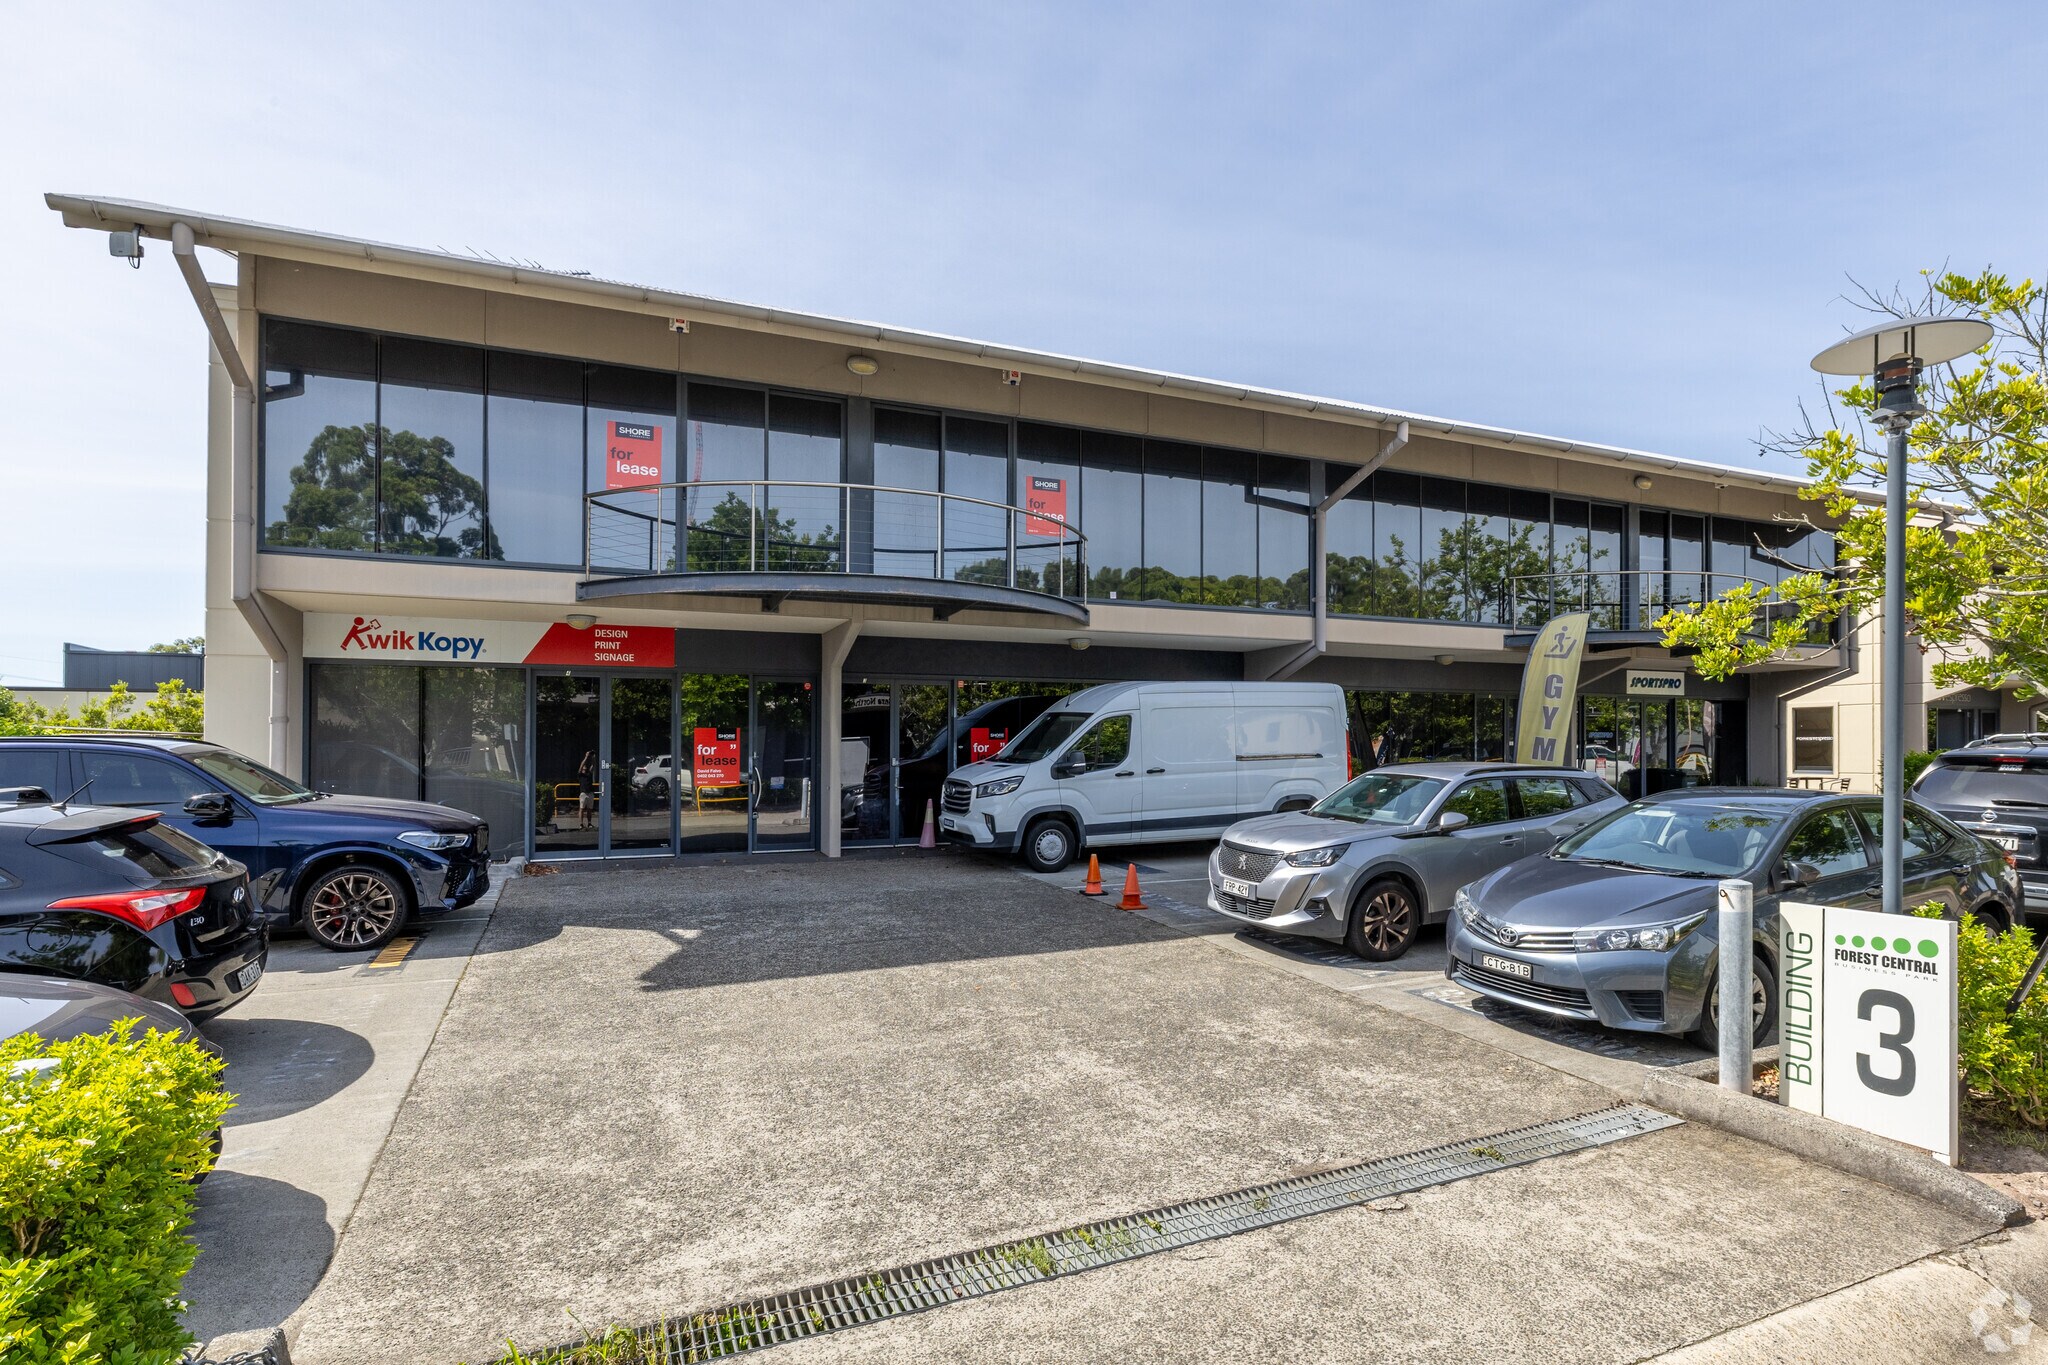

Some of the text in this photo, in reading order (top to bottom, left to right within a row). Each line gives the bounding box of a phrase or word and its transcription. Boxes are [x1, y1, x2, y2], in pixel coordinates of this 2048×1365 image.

[619, 427, 650, 437] SHORE
[610, 447, 633, 460] for
[616, 460, 659, 477] lease
[1029, 498, 1046, 509] for
[594, 629, 628, 638] DESIGN
[594, 641, 621, 650] PRINT
[594, 652, 635, 662] SIGNAGE
[1630, 677, 1681, 689] SPORTSPRO
[1532, 674, 1564, 762] GYM
[697, 744, 717, 755] for
[973, 743, 990, 752] for
[702, 755, 737, 766] lease
[190, 916, 205, 926] i30
[1834, 948, 1939, 976] FOREST CENTRAL
[1834, 962, 1938, 983] BUSINESS PARK
[1785, 931, 1813, 1085] BUILDING
[1856, 988, 1917, 1097] 3
